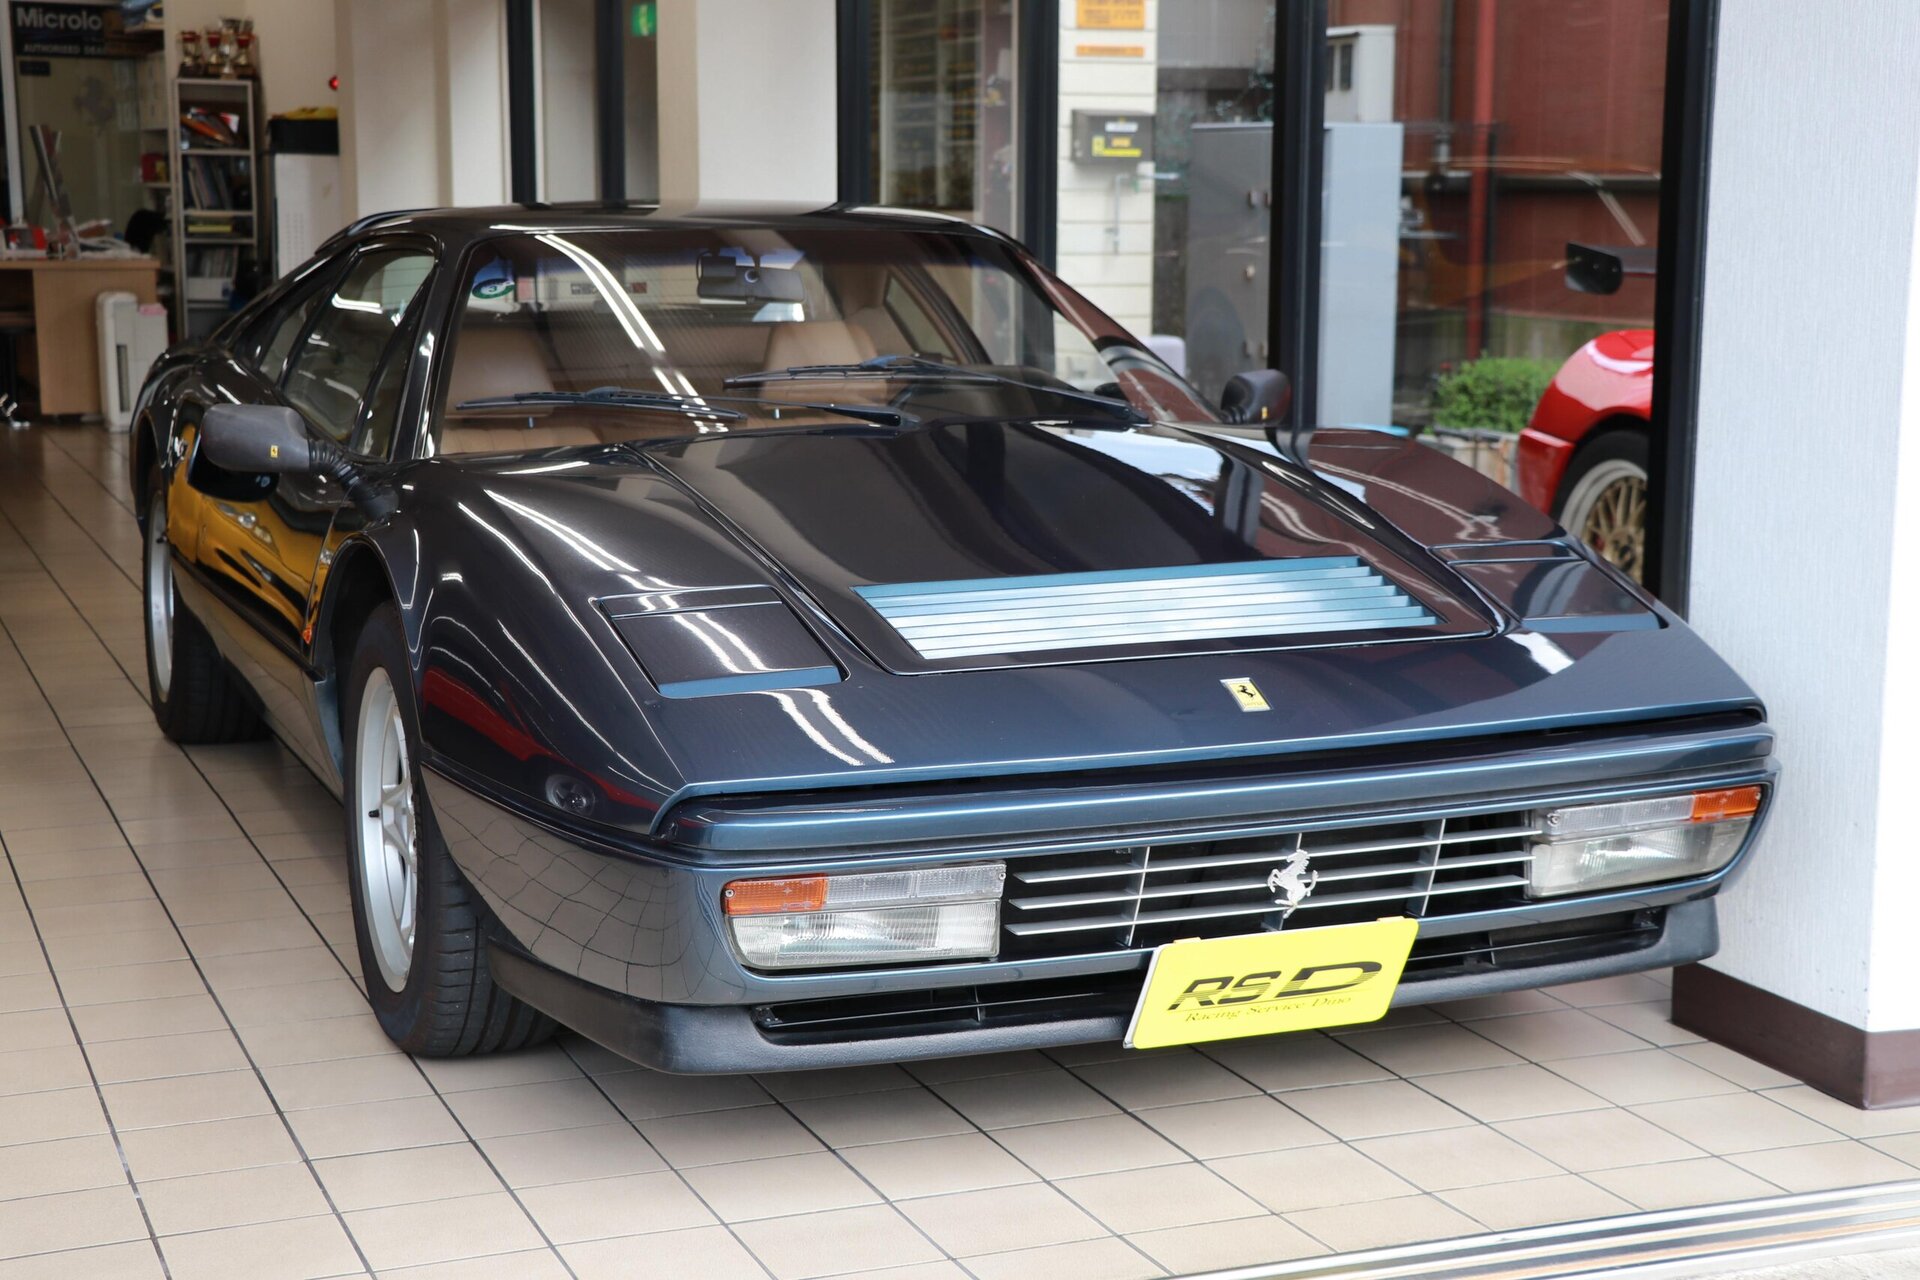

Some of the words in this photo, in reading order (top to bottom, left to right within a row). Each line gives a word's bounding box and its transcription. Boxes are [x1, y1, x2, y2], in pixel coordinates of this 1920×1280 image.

[1167, 961, 1382, 1010] RSD
[1185, 1010, 1241, 1022] Racing
[1246, 1001, 1306, 1016] Service
[1311, 996, 1352, 1008] Dino
